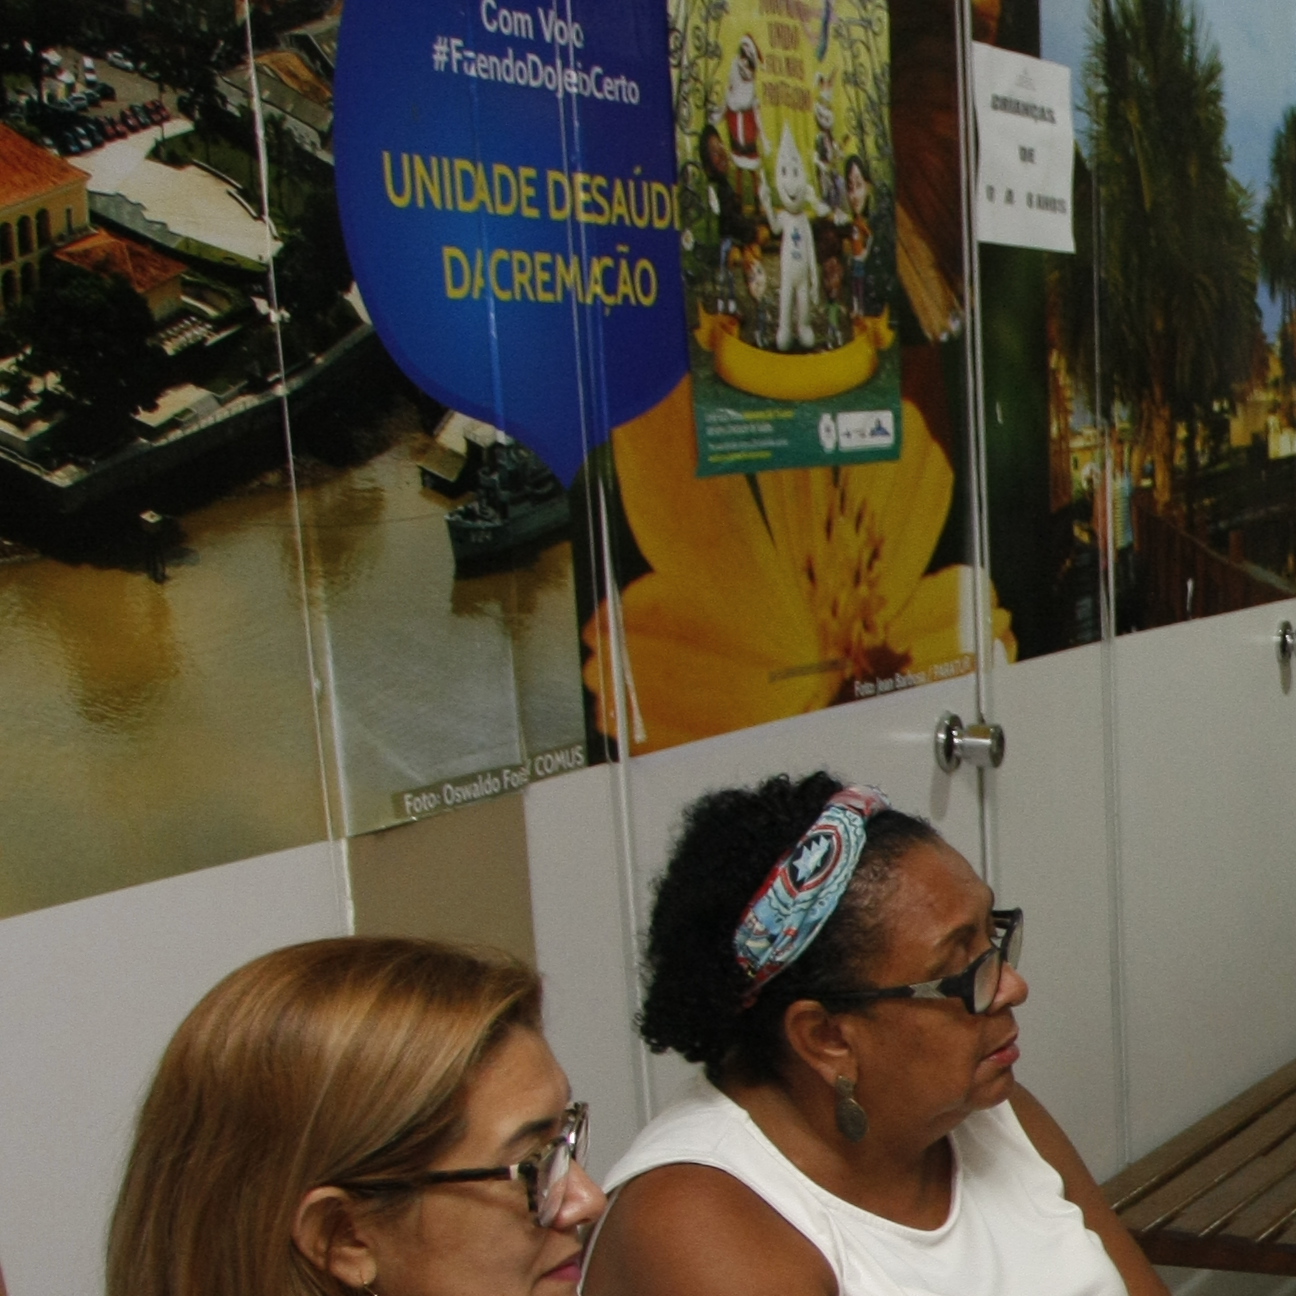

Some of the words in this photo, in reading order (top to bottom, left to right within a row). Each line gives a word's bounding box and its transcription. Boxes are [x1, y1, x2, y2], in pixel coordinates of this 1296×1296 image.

[480, 0, 534, 41] Com
[1018, 145, 1036, 164] DE
[382, 150, 540, 218] UNIDADE
[442, 772, 500, 806] Oswaldo
[534, 745, 585, 776] COMUS
